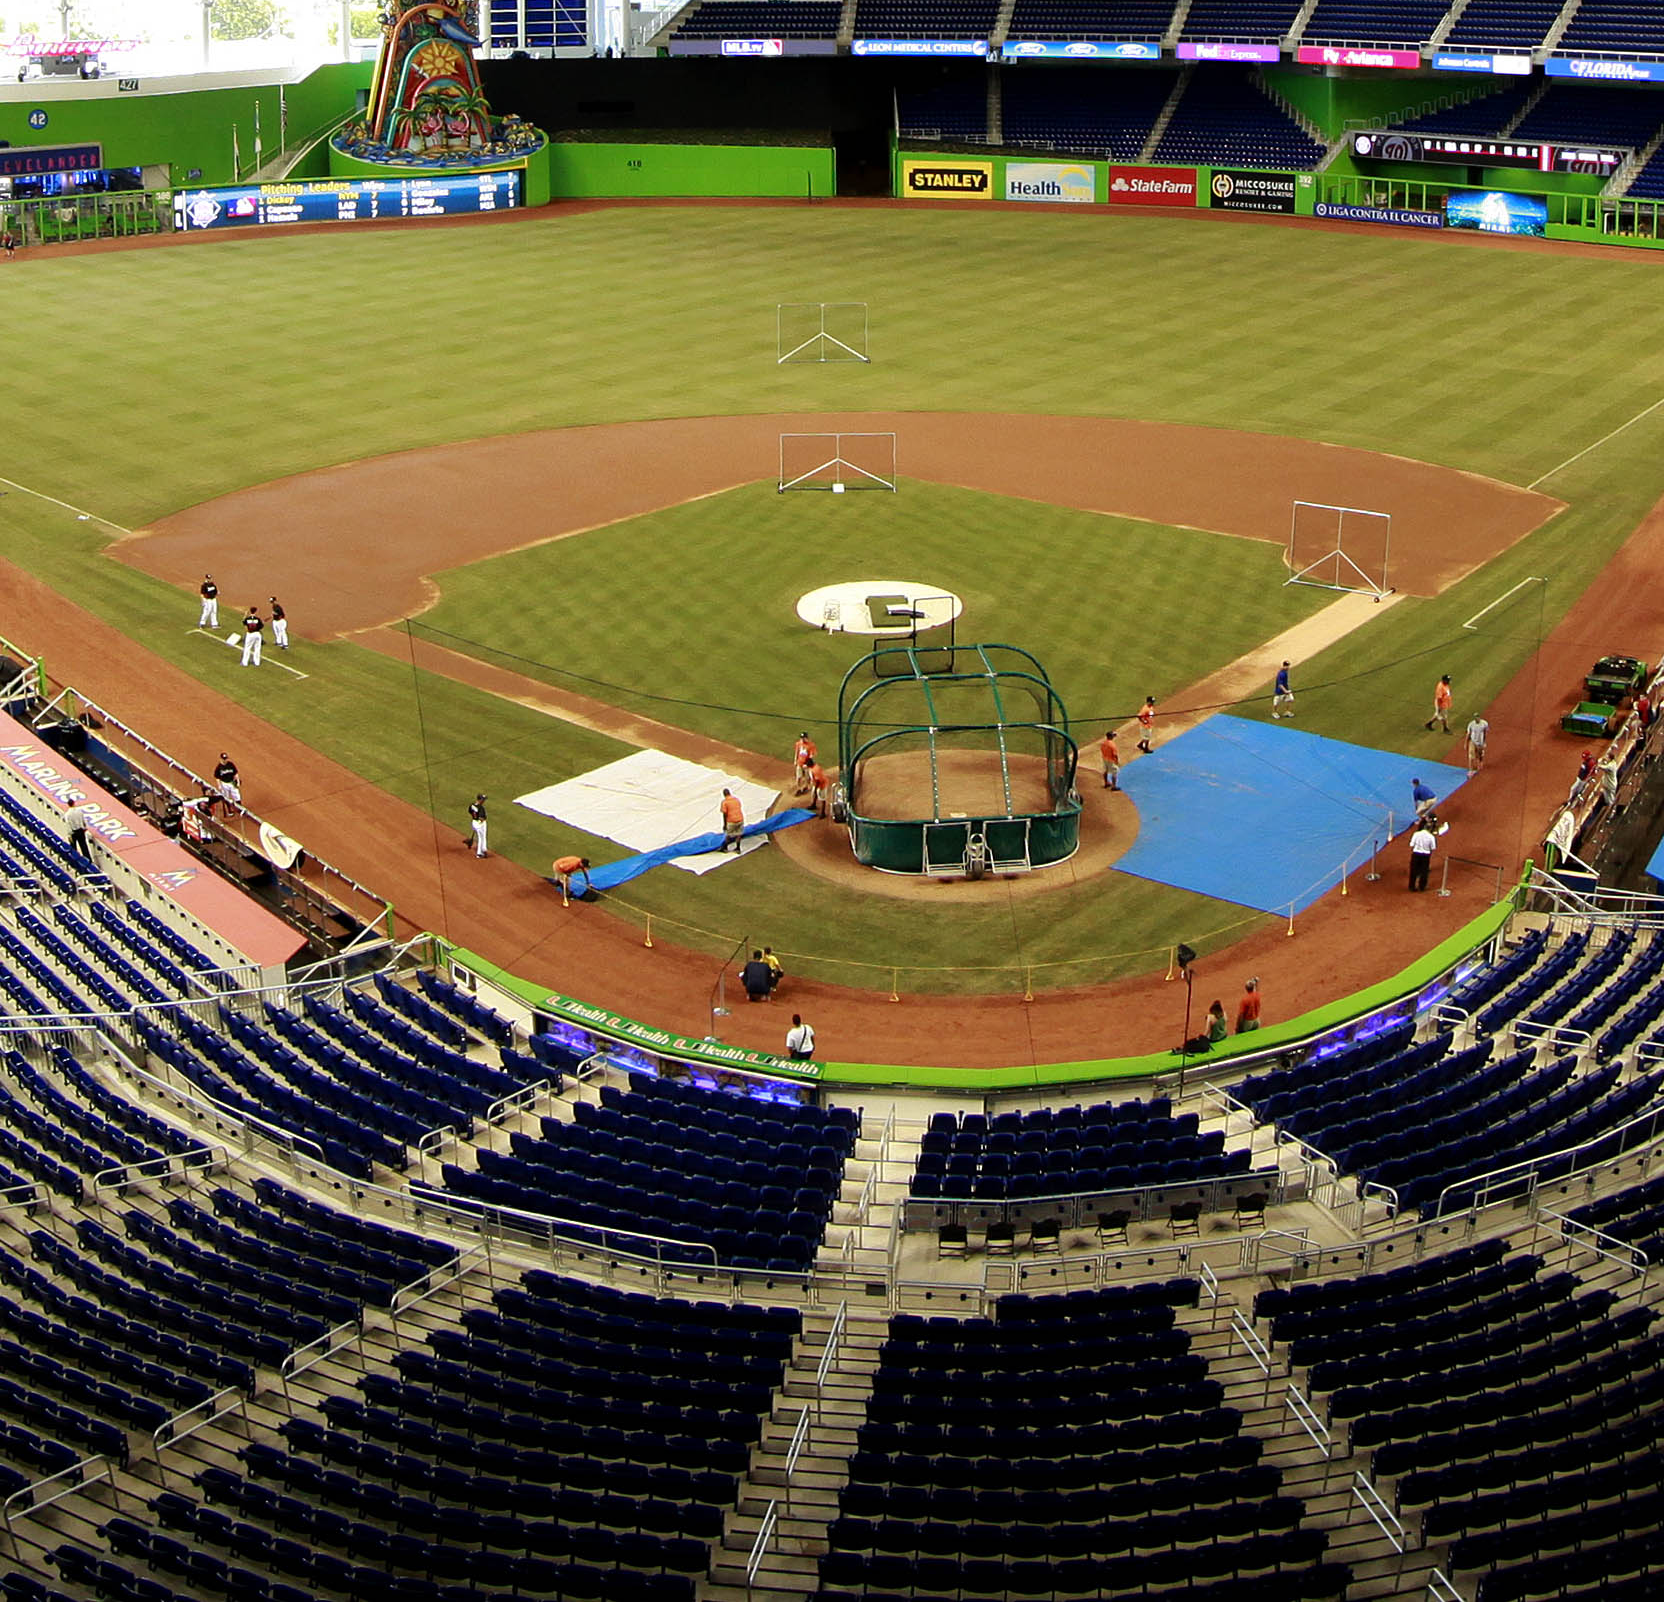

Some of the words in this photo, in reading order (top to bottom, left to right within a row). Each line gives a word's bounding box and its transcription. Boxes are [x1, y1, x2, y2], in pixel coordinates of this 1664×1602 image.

[868, 42, 891, 53] LEON
[892, 42, 931, 53] MEDICAL
[932, 42, 972, 53] CENTERS
[30, 113, 46, 126] 42
[914, 173, 983, 188] STANLEY
[1235, 179, 1294, 191] MICCOSUKEE
[260, 184, 304, 195] Pitching
[309, 181, 351, 192] Leaders
[267, 196, 295, 205] Dickey
[338, 201, 357, 210] LAD
[1327, 205, 1349, 217] LIGA
[1349, 207, 1388, 220] CONTRA
[1389, 212, 1400, 222] EL
[1400, 212, 1440, 226] CANCER
[0, 744, 86, 803] MARLINS
[82, 802, 136, 842] PARK
